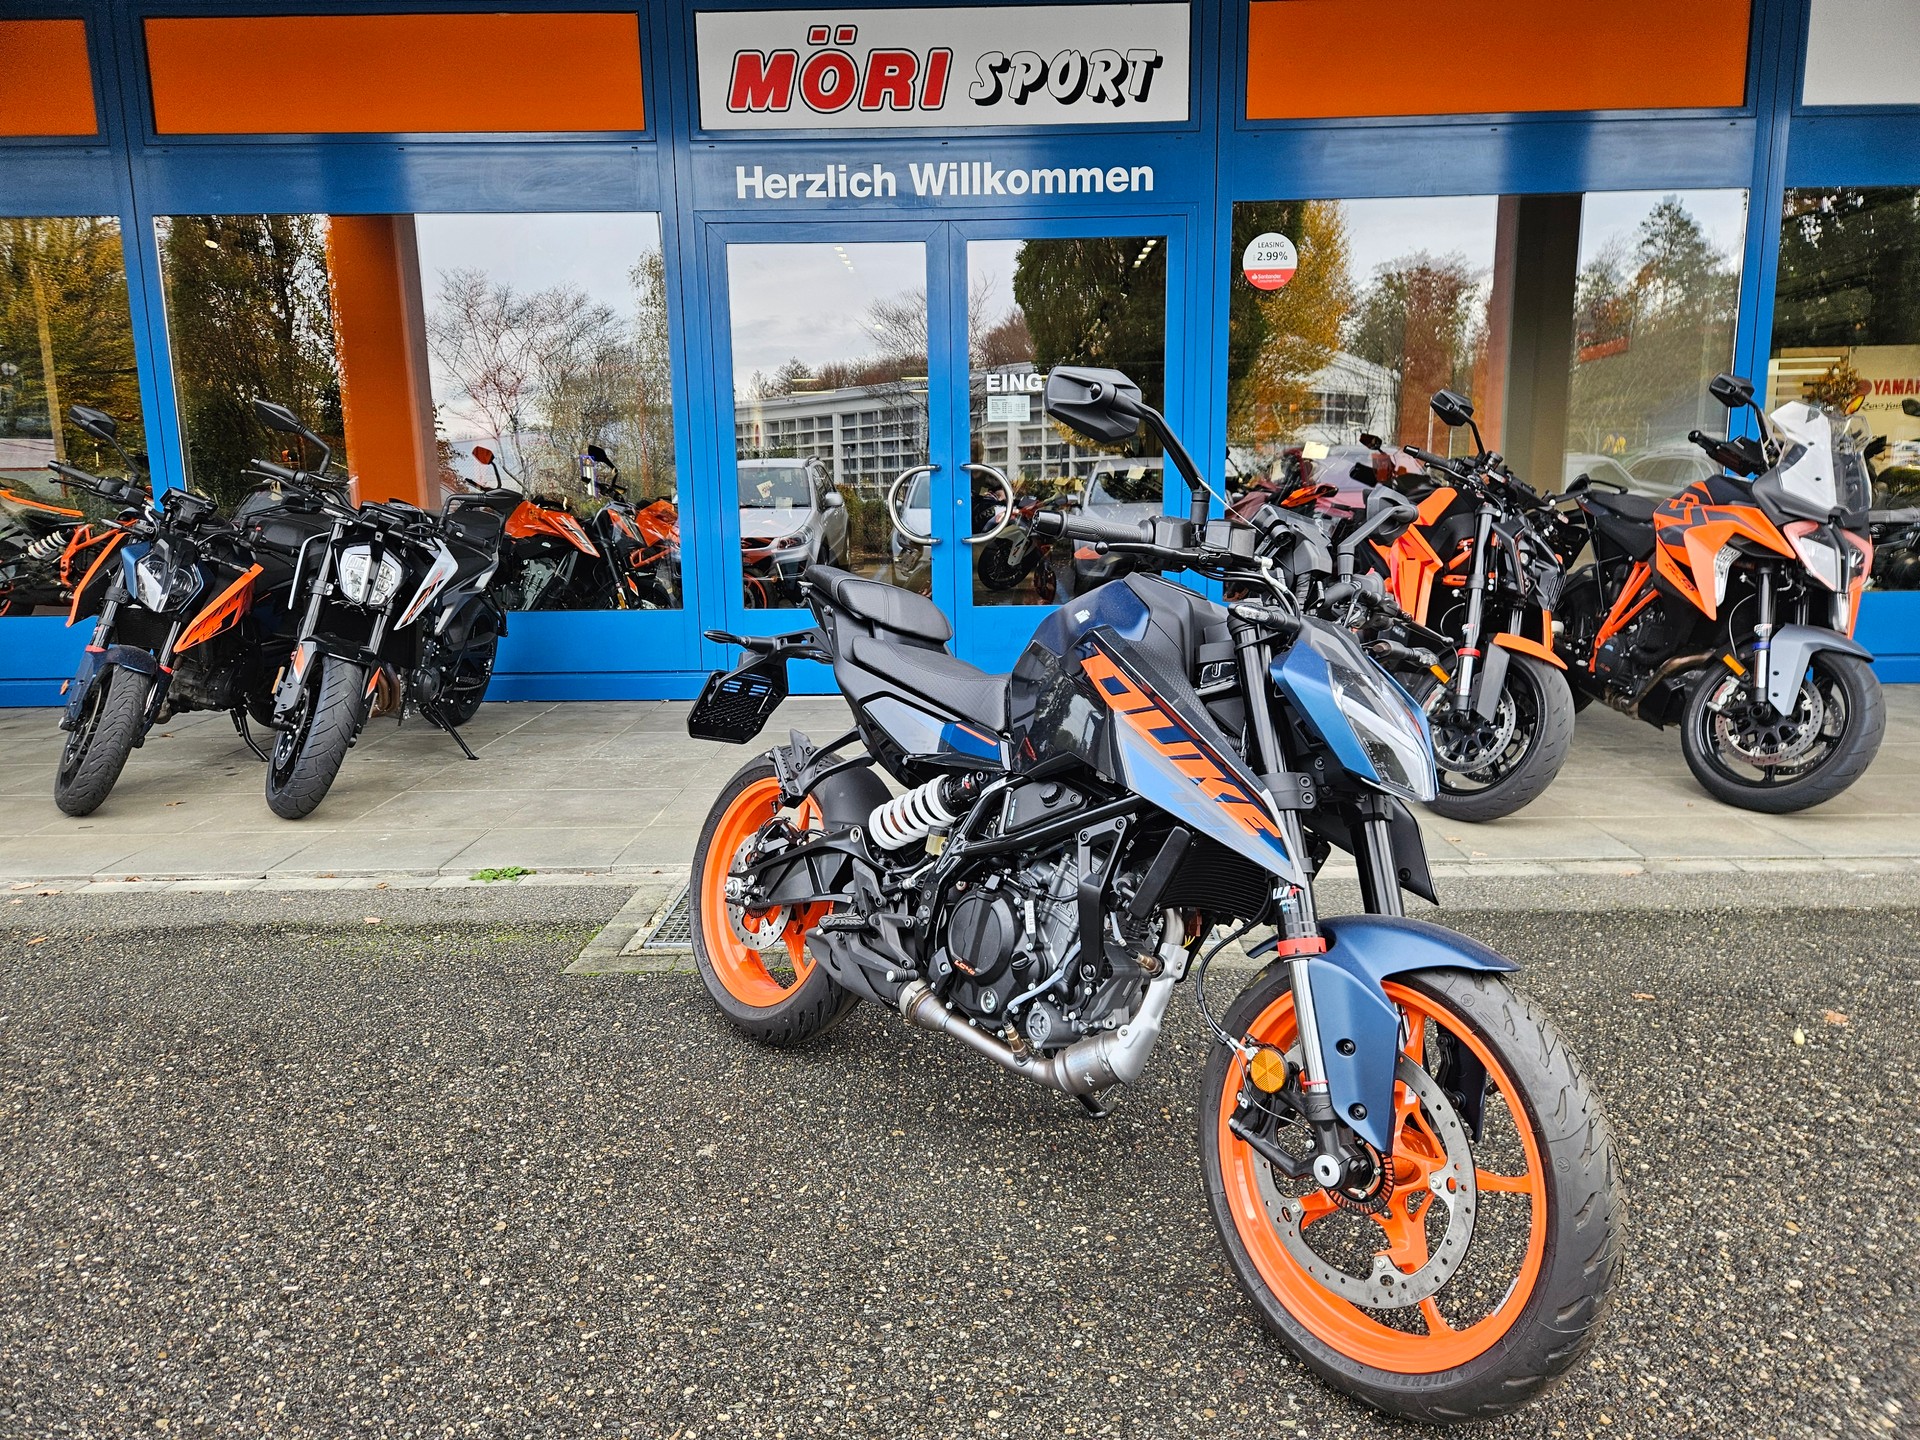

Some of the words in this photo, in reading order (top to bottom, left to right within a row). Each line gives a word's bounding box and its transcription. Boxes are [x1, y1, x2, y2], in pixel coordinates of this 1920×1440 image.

[726, 25, 953, 114] MÖRI
[969, 48, 1163, 107] SPORT
[736, 164, 896, 199] Herzlich
[909, 161, 1154, 196] Willkommen
[1257, 251, 1288, 261] 2.99%
[986, 373, 1044, 391] EING
[1080, 642, 1282, 838] DUKE
[1370, 1371, 1453, 1387] MICHELIN
